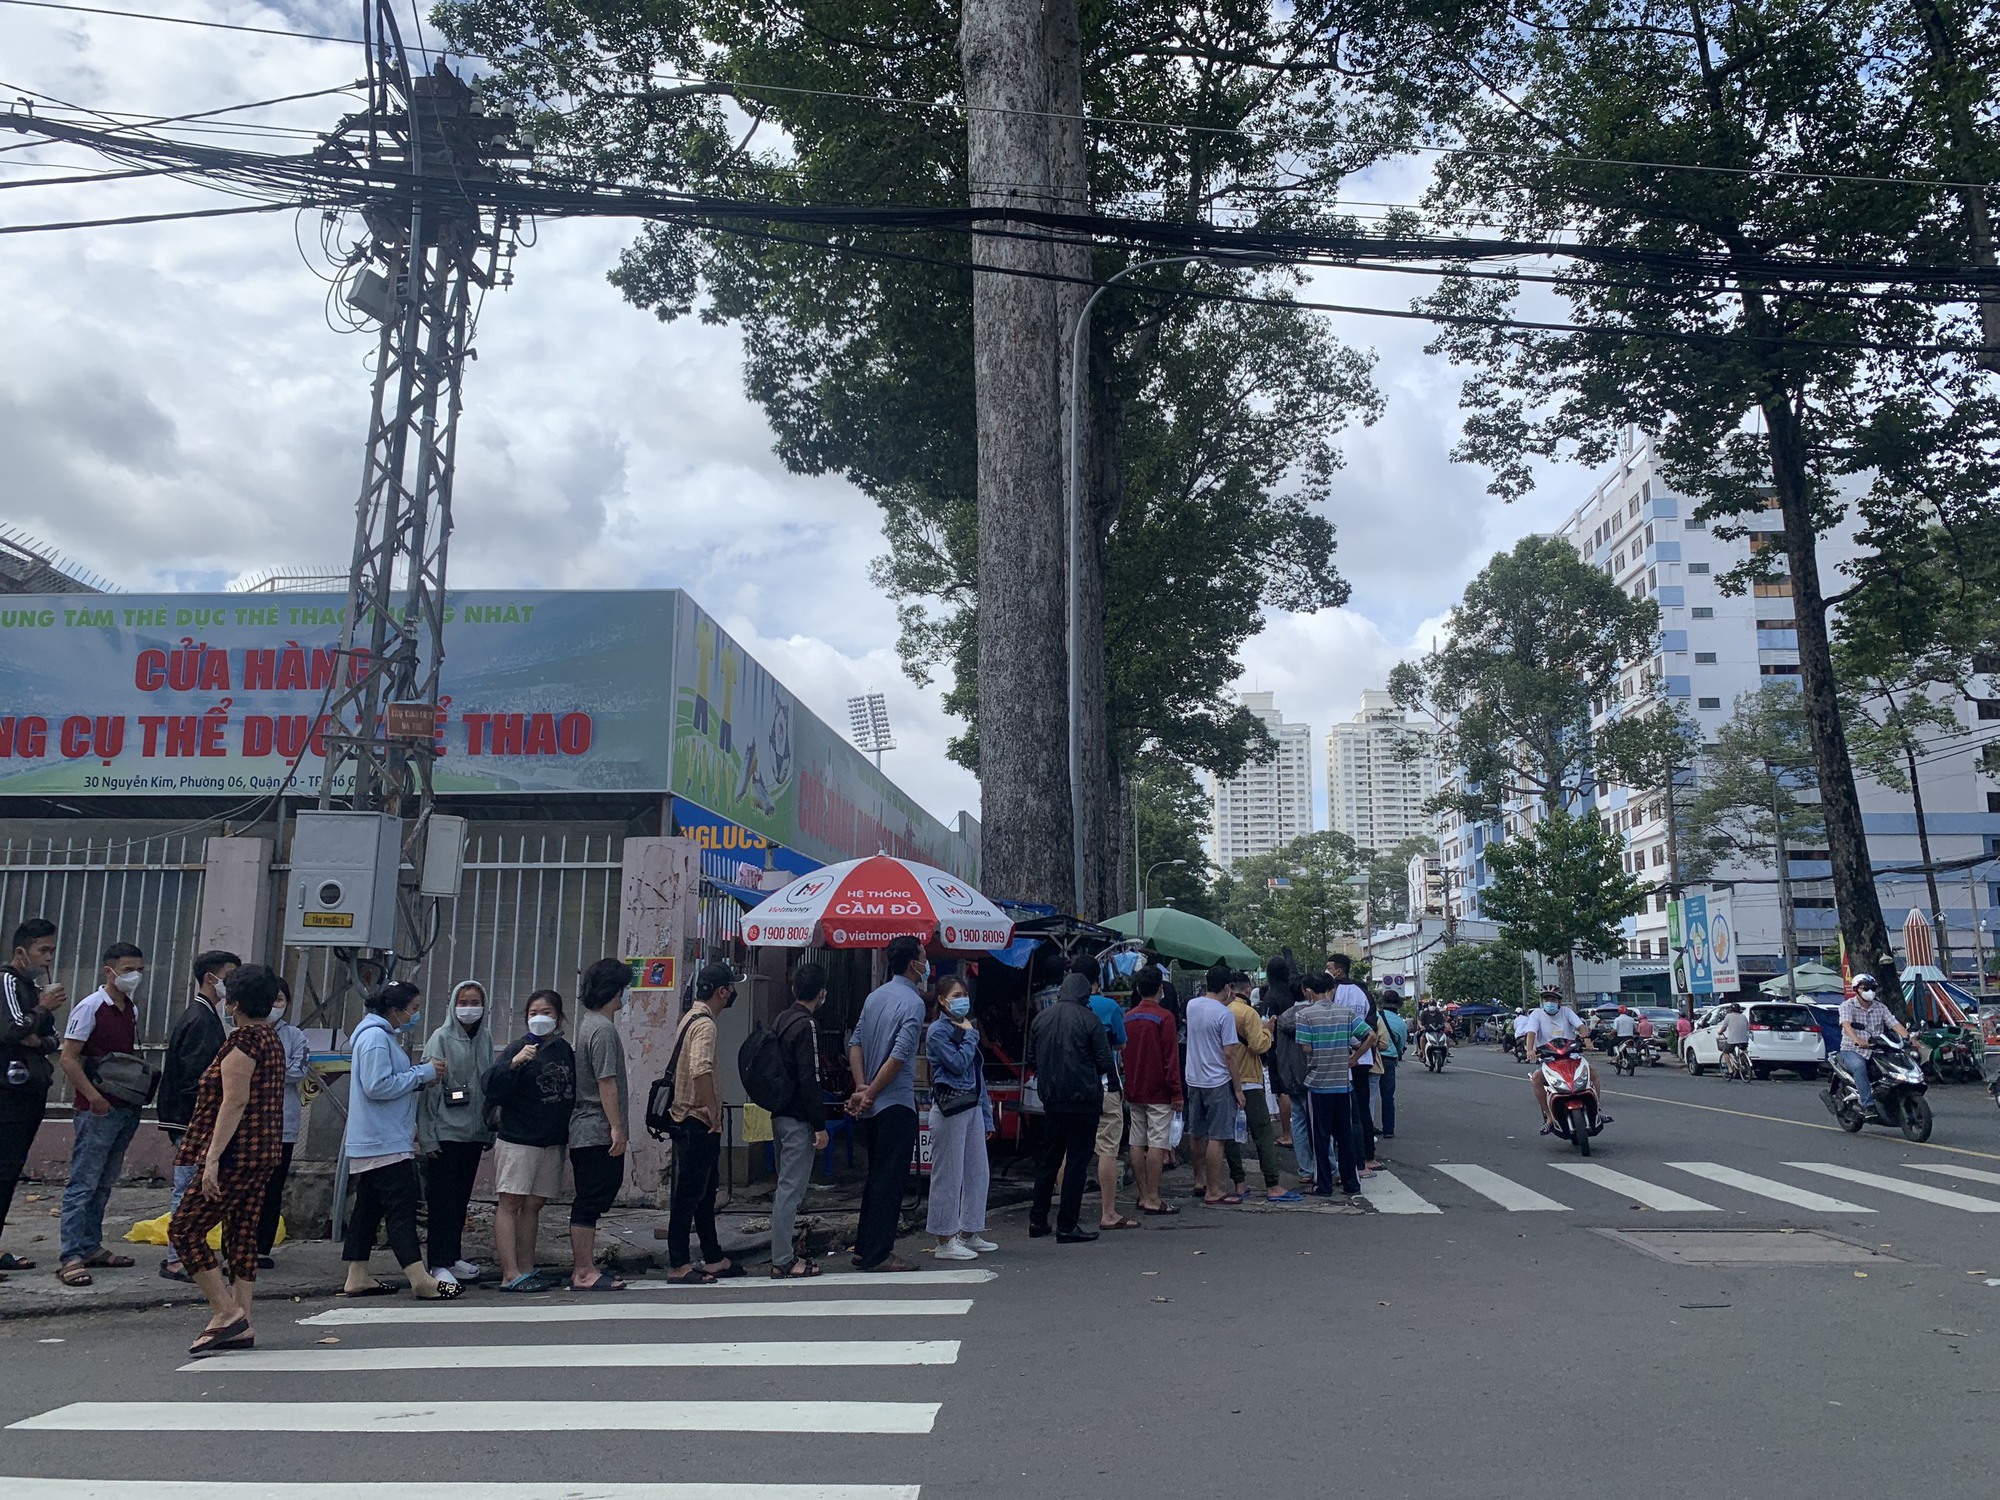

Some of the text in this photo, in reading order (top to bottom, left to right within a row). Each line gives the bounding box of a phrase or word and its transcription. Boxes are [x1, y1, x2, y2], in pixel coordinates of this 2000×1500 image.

[64, 606, 115, 627] TÂM
[176, 608, 226, 631] DỤC
[464, 600, 535, 623] NHẤT
[135, 637, 371, 691] CỬA HÀNG
[60, 715, 126, 766] CỤ
[138, 697, 233, 757] THỂ
[242, 715, 333, 766] DỤC
[462, 711, 593, 756] THAO
[84, 776, 99, 788] 30
[102, 774, 148, 790] Nguyễn
[151, 776, 177, 790] Kim,
[180, 776, 225, 790] Phường
[227, 776, 247, 790] 06,
[250, 776, 280, 790] Quận
[847, 888, 911, 899] HỆ THỐNG
[835, 900, 922, 915] CẦM ĐỒ
[763, 927, 810, 940] 1900 8009
[958, 928, 1005, 943] 1900 8009
